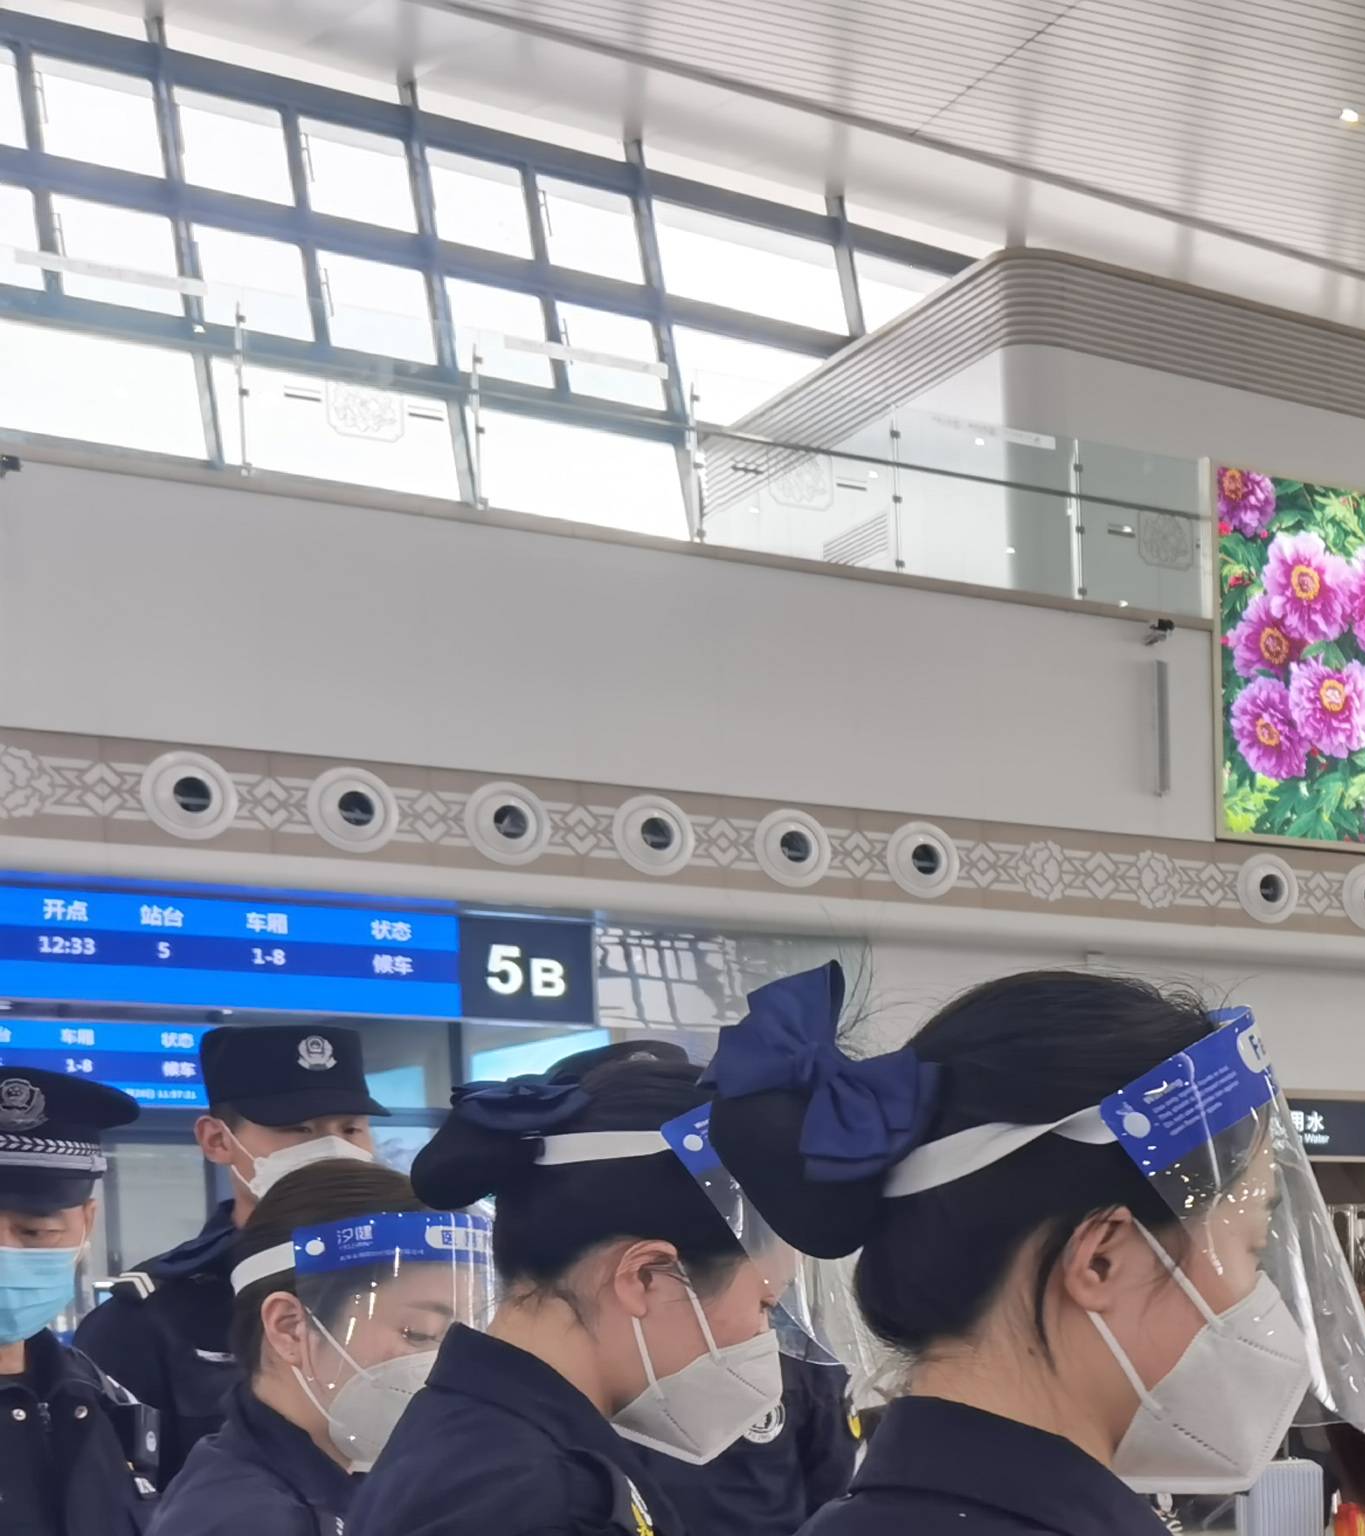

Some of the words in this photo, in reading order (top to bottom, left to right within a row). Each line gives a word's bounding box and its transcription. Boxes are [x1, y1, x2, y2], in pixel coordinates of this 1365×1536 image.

[43, 898, 88, 921] 开点
[140, 905, 184, 928] 站台
[371, 920, 412, 942] 状态
[38, 936, 96, 955] 12:33
[157, 941, 171, 959] 5
[252, 948, 286, 966] 1-8
[372, 954, 414, 976] 候车
[485, 944, 567, 998] 5B
